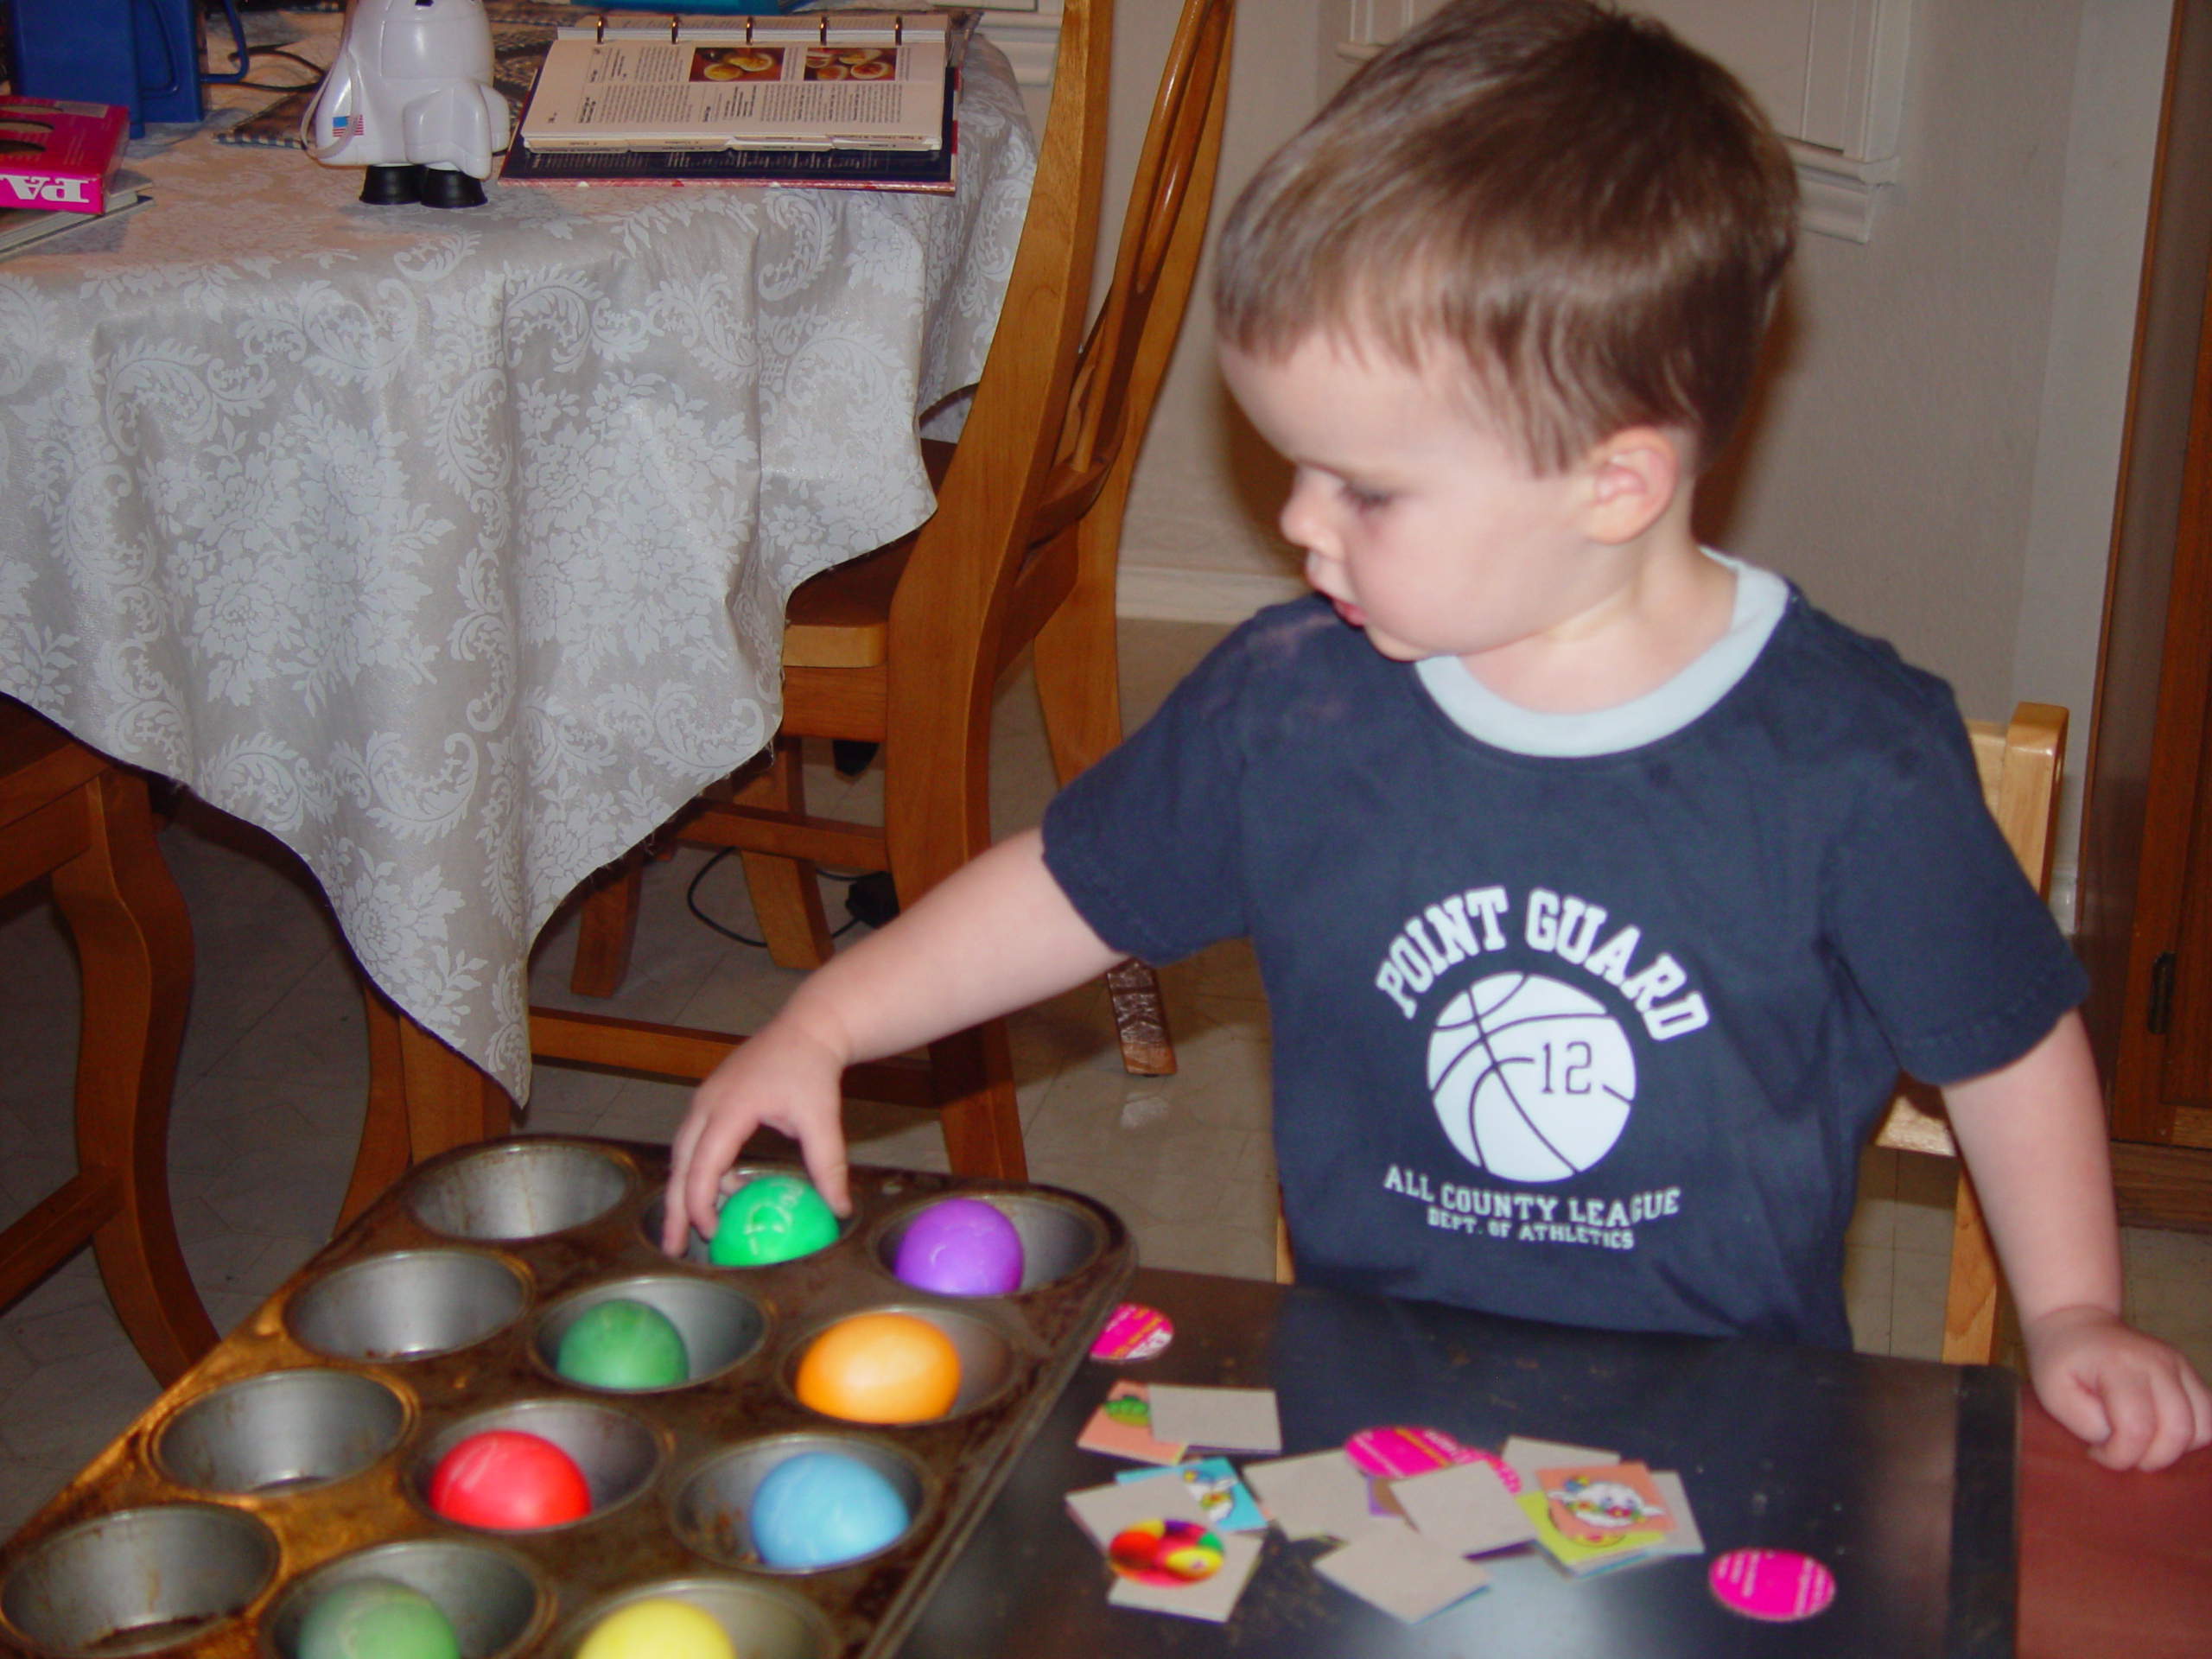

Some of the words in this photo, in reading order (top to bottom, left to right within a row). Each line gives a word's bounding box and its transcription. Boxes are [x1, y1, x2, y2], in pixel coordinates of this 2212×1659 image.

[1376, 885, 1510, 1020] POINT
[1524, 887, 1710, 1041] GUARD
[1541, 1040, 1593, 1095] 12
[1383, 1163, 1434, 1203] ALL
[1440, 1181, 1560, 1223] COUNTY
[1568, 1186, 1681, 1229] LEAGUE
[1487, 1220, 1512, 1238] OF
[1518, 1222, 1636, 1250] ATHLETICS
